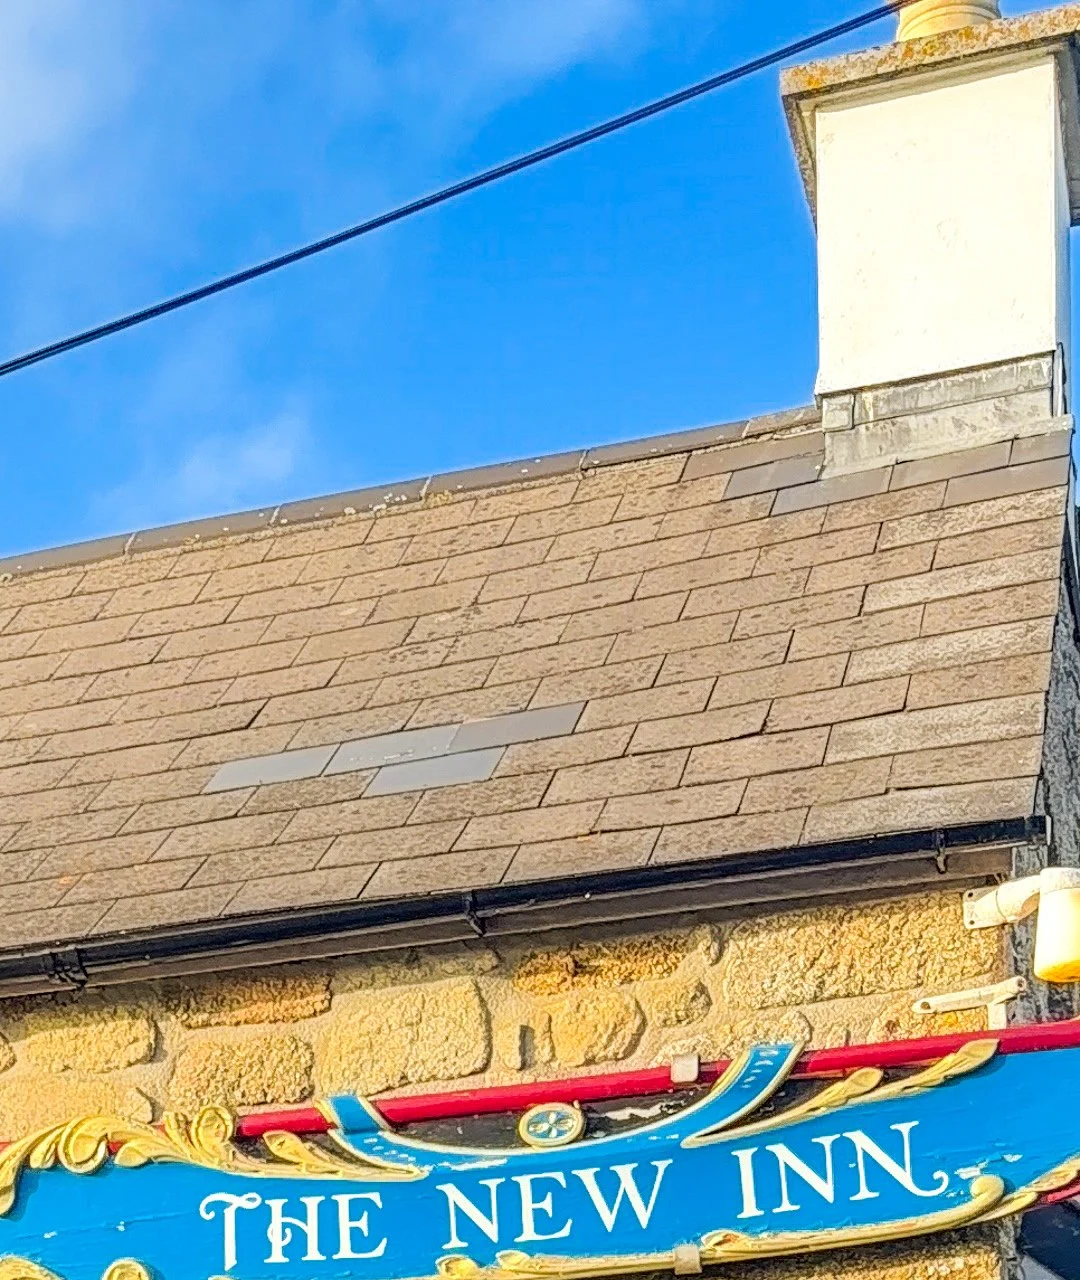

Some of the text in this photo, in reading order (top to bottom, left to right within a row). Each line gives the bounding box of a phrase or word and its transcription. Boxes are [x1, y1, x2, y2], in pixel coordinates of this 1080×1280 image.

[199, 1120, 949, 1271] THE NEW INN
